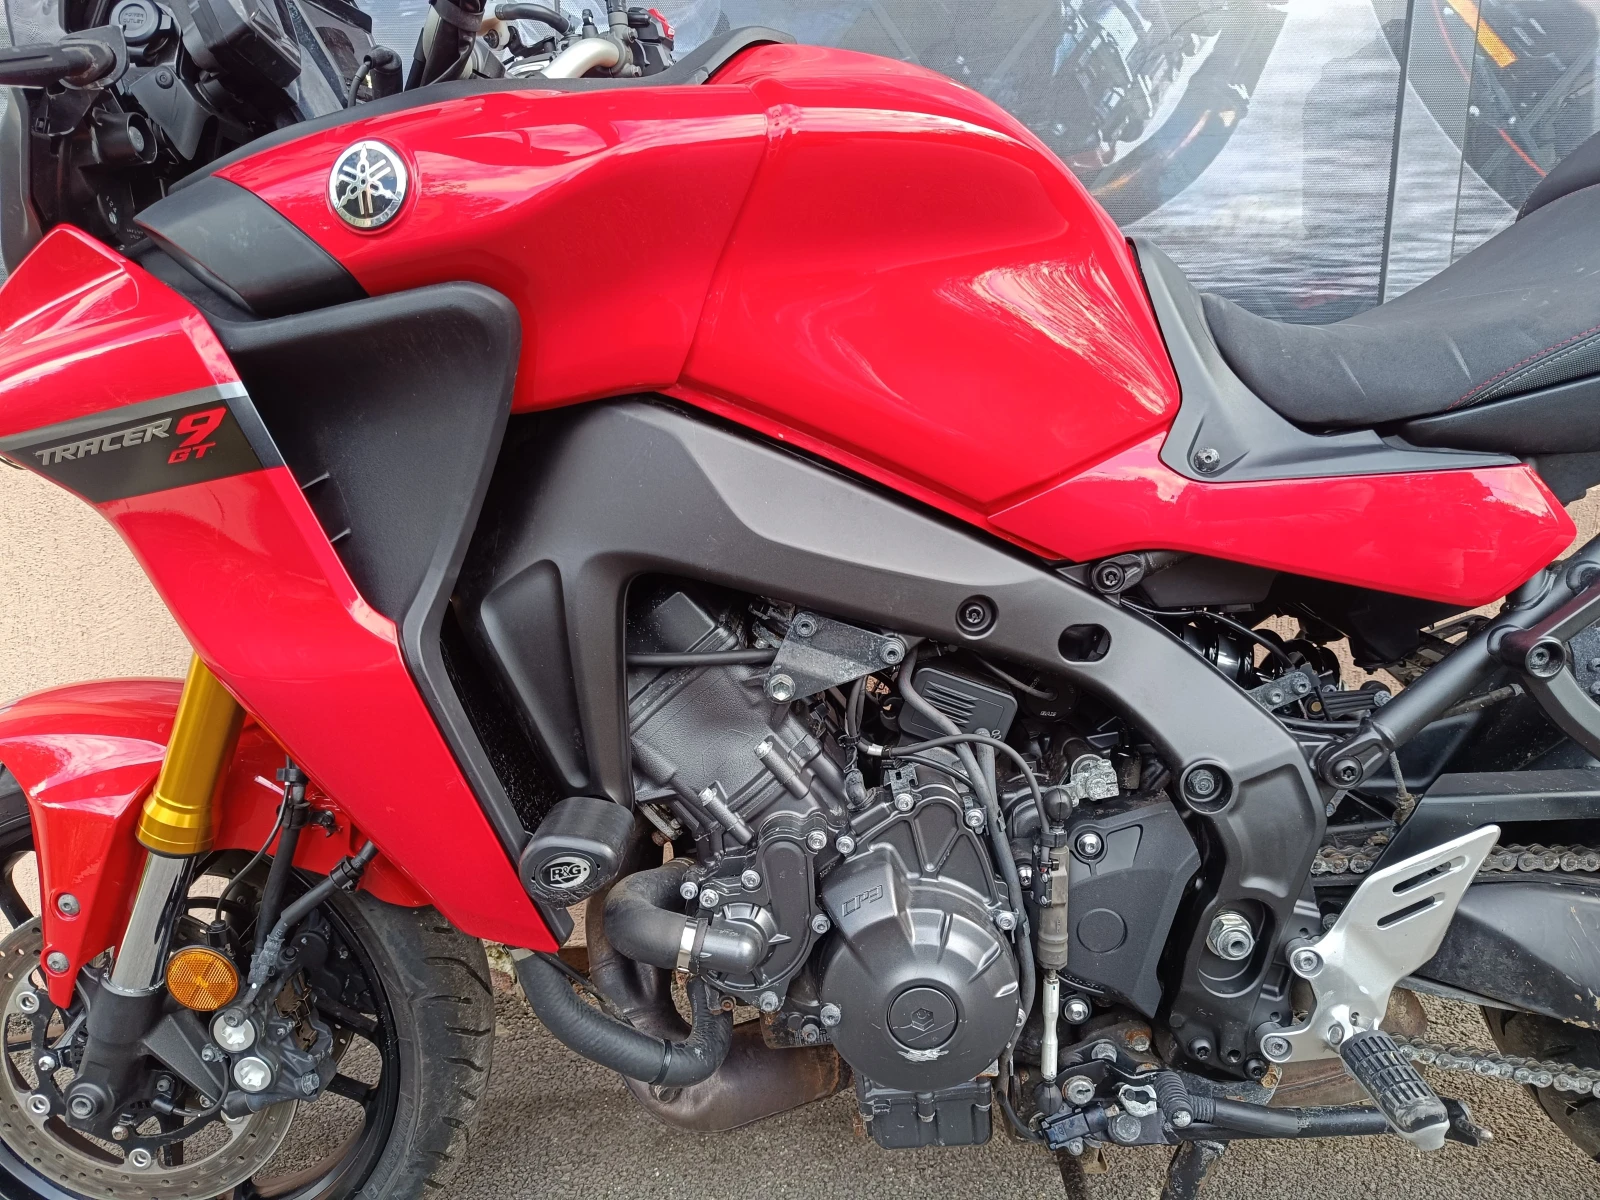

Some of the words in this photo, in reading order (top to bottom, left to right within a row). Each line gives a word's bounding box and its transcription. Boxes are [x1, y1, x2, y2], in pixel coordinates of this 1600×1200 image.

[35, 417, 173, 466] TRACER
[175, 406, 227, 447] 9
[167, 441, 216, 464] GT
[551, 865, 582, 881] R&G
